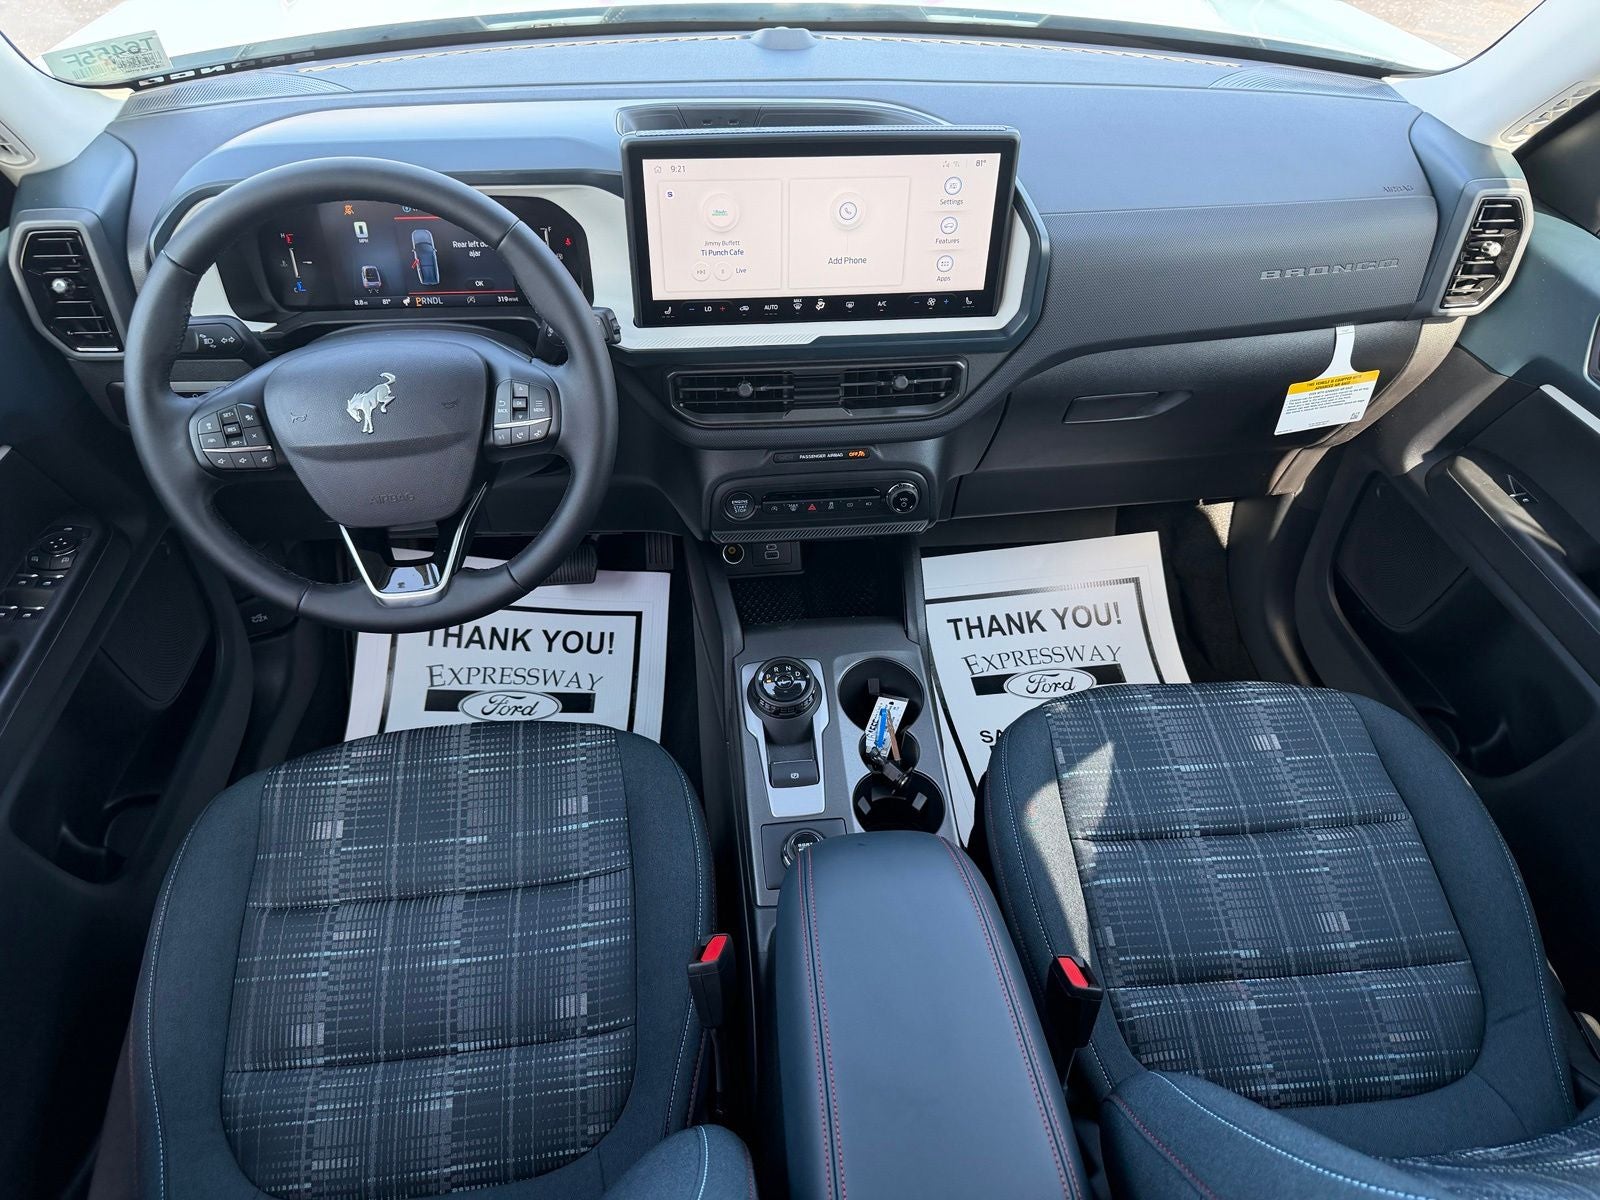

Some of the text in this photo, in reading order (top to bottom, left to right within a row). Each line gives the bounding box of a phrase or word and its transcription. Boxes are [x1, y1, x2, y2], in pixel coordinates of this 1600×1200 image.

[670, 165, 686, 173] 9:21
[939, 198, 964, 206] Settings
[452, 240, 467, 248] Rear
[468, 240, 480, 248] left
[935, 237, 960, 245] Features
[469, 250, 481, 258] ajar
[827, 256, 867, 265] Add Phone
[1260, 258, 1399, 280] BRONCO
[936, 275, 951, 283] Apps
[415, 296, 444, 307] PRNDL
[946, 602, 1122, 641] THANK YOU!
[427, 624, 615, 655] THANK YOU!
[961, 644, 1122, 677] EXPRESSWAY
[426, 663, 604, 692] EXPRESSWAY
[1025, 672, 1077, 695] Ford
[480, 693, 540, 717] Ford
